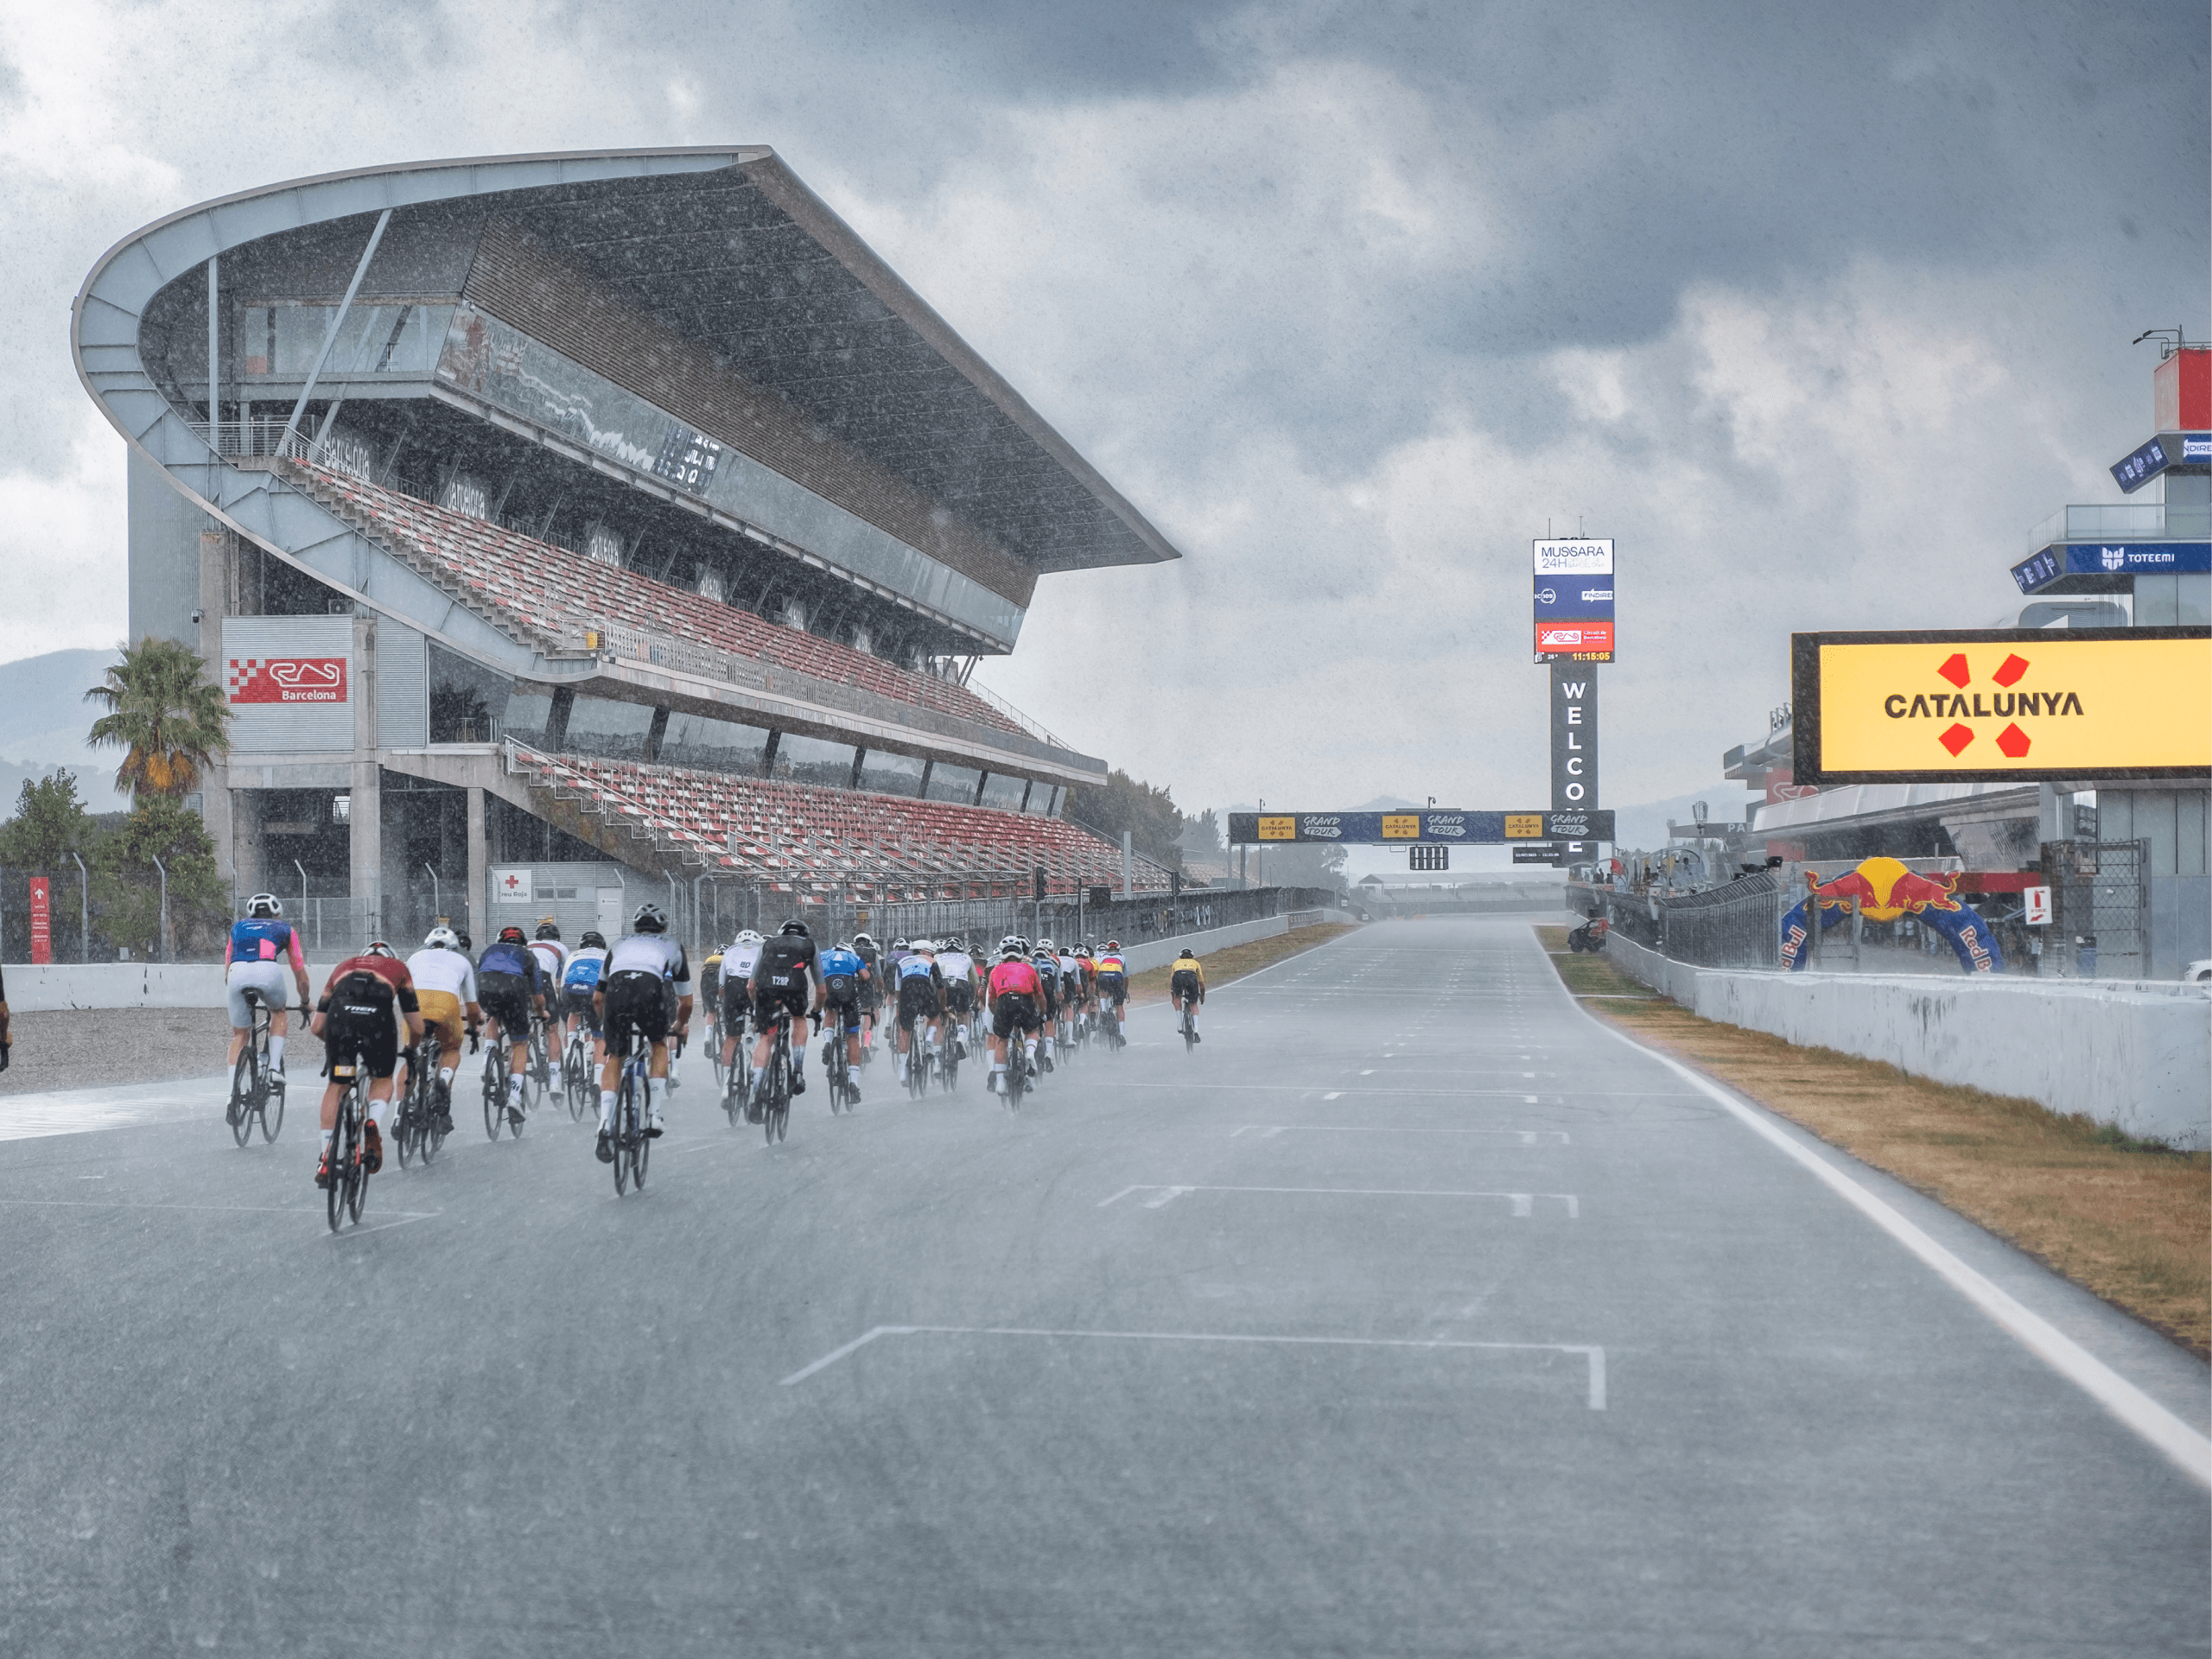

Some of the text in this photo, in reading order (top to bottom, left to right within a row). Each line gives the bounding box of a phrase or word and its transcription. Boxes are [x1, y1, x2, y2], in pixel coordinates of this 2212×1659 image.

[1541, 546, 1605, 556] MUSSARA
[2127, 553, 2175, 563] TOTEEMI
[1542, 558, 1567, 569] 24H
[282, 690, 336, 701] Barcelona
[1885, 692, 2084, 718] CATALUNYA
[1562, 683, 1586, 852] WELCOE
[1304, 816, 1340, 825] GRAND
[1427, 815, 1465, 824] GRAND
[1550, 814, 1588, 823] GRAND
[1307, 827, 1336, 836] TOUR
[1432, 826, 1460, 835] TOUR
[1554, 825, 1583, 834] TOUR
[1782, 925, 1807, 957] Bull
[1960, 925, 1989, 959] Red
